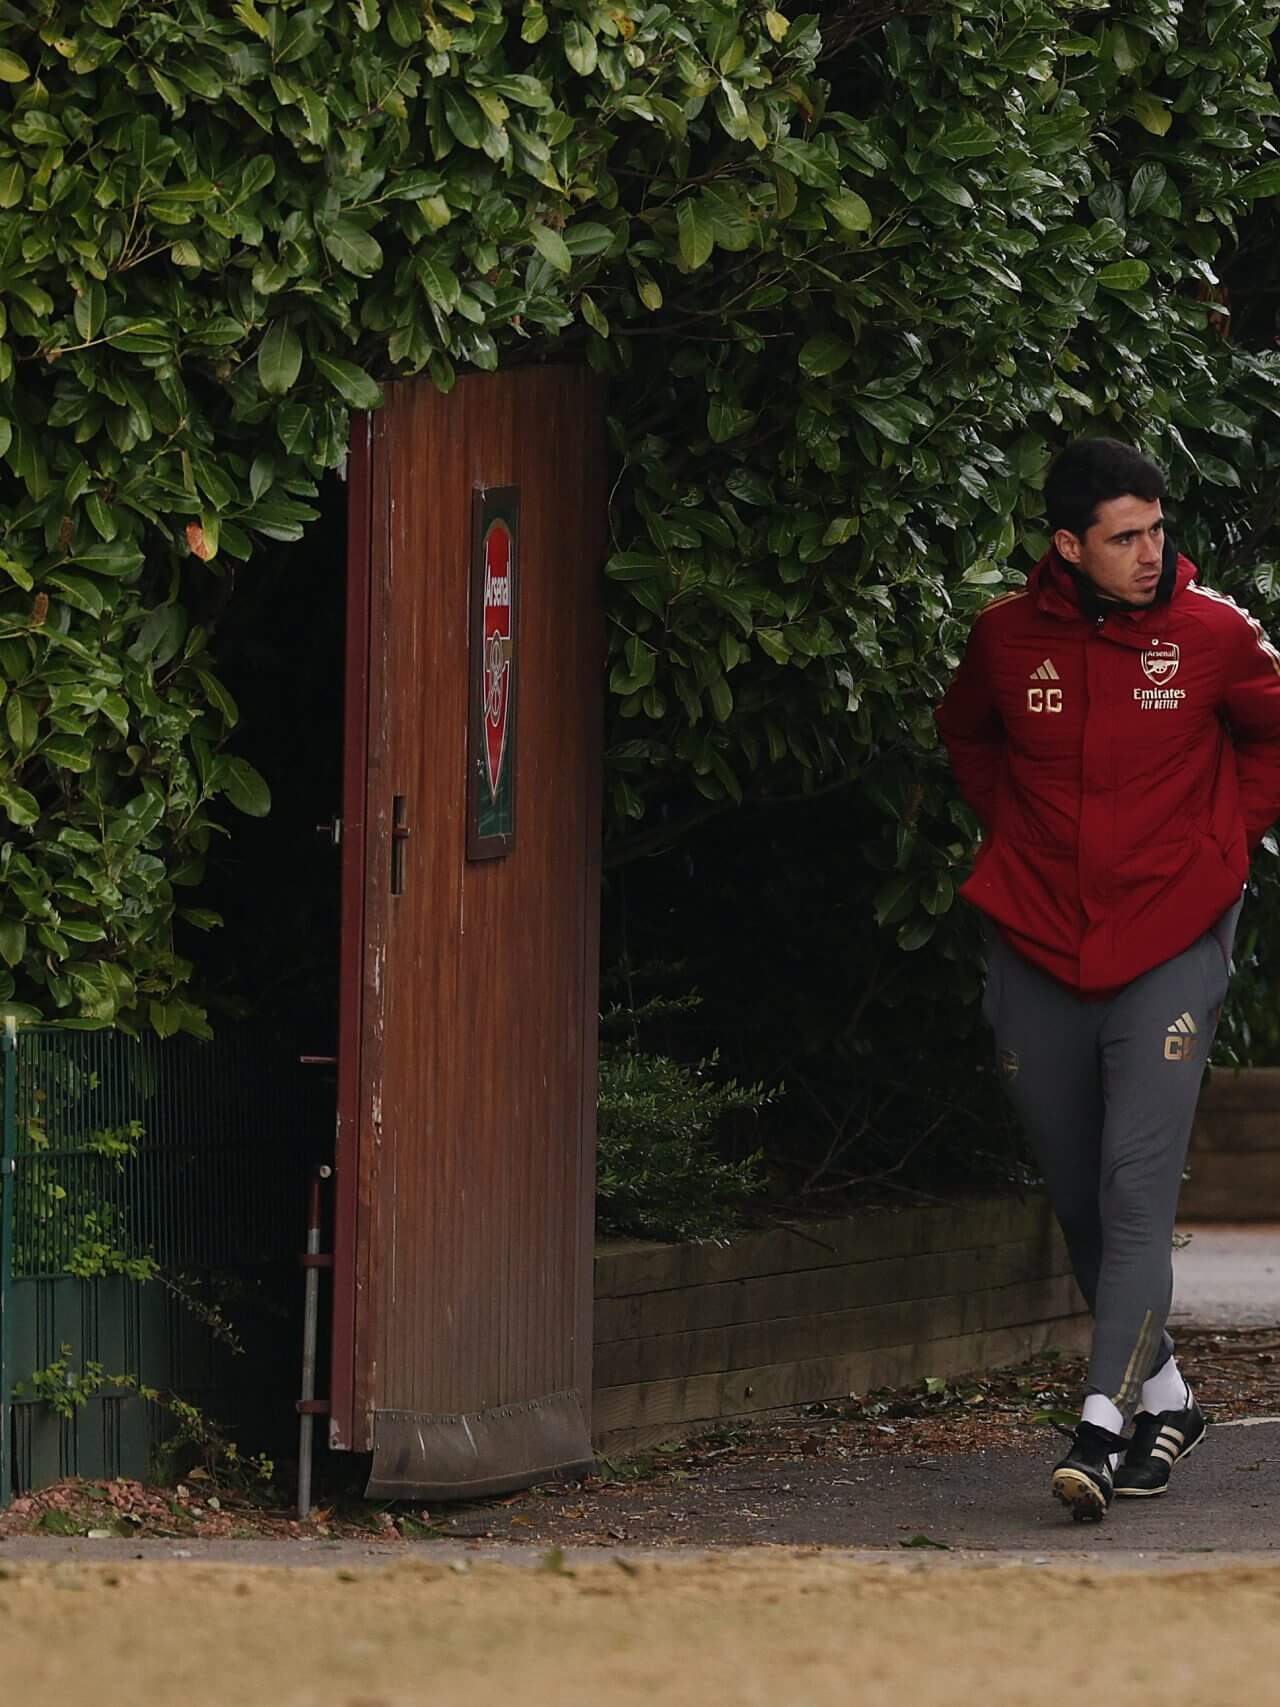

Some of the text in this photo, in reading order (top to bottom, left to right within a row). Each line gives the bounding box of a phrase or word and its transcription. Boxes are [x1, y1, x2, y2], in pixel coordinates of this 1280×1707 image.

[484, 563, 511, 607] Arsenal
[1133, 687, 1186, 700] Emirates
[1140, 699, 1178, 710] FLY BETTER
